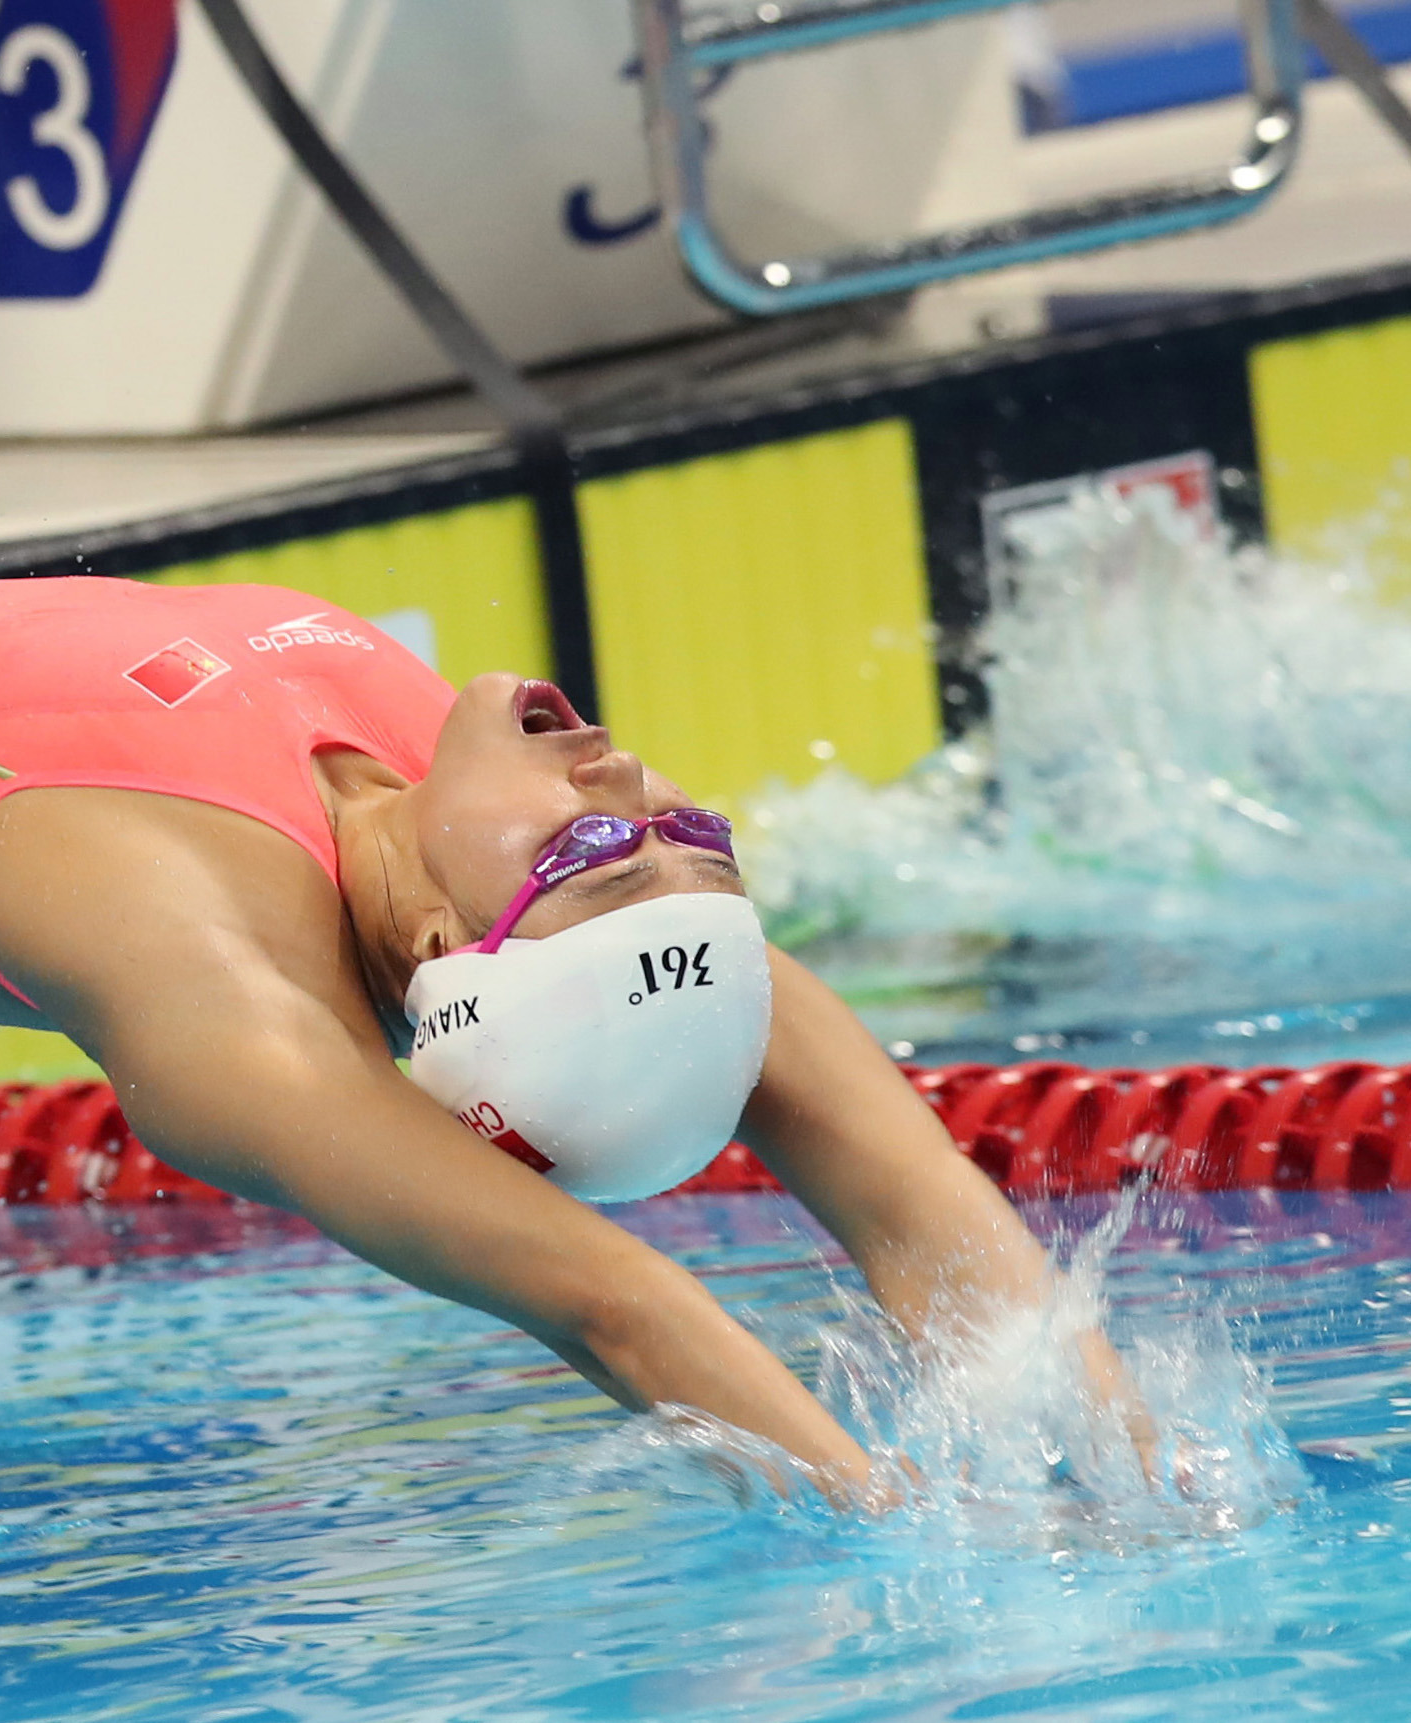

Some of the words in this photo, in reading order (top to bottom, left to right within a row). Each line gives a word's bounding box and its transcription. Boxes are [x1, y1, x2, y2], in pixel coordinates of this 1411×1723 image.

[247, 628, 375, 653] speedo
[546, 858, 588, 884] SWANS
[416, 995, 480, 1050] XIANG
